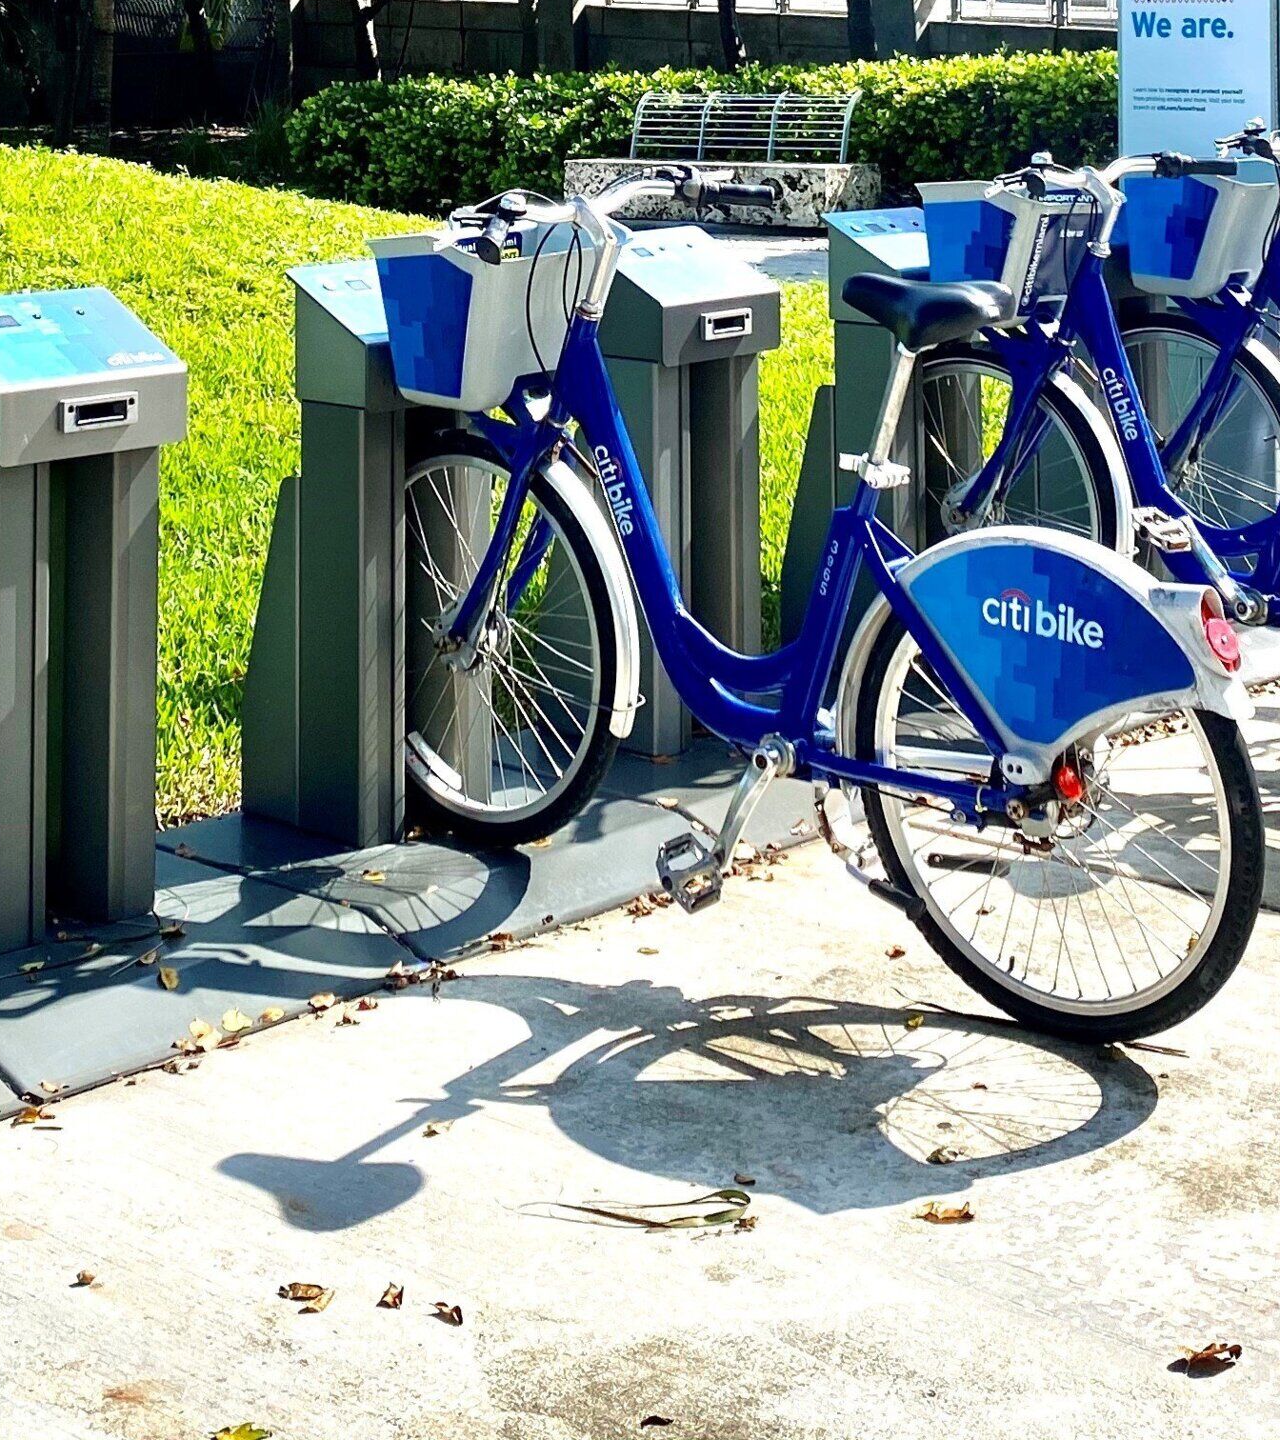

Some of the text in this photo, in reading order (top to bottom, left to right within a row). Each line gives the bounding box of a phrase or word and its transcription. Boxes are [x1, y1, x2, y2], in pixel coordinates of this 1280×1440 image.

[1131, 12, 1234, 39] We are.
[1102, 367, 1138, 441] citi bike
[594, 445, 634, 536] citi bike
[982, 595, 1104, 649] citi bike
